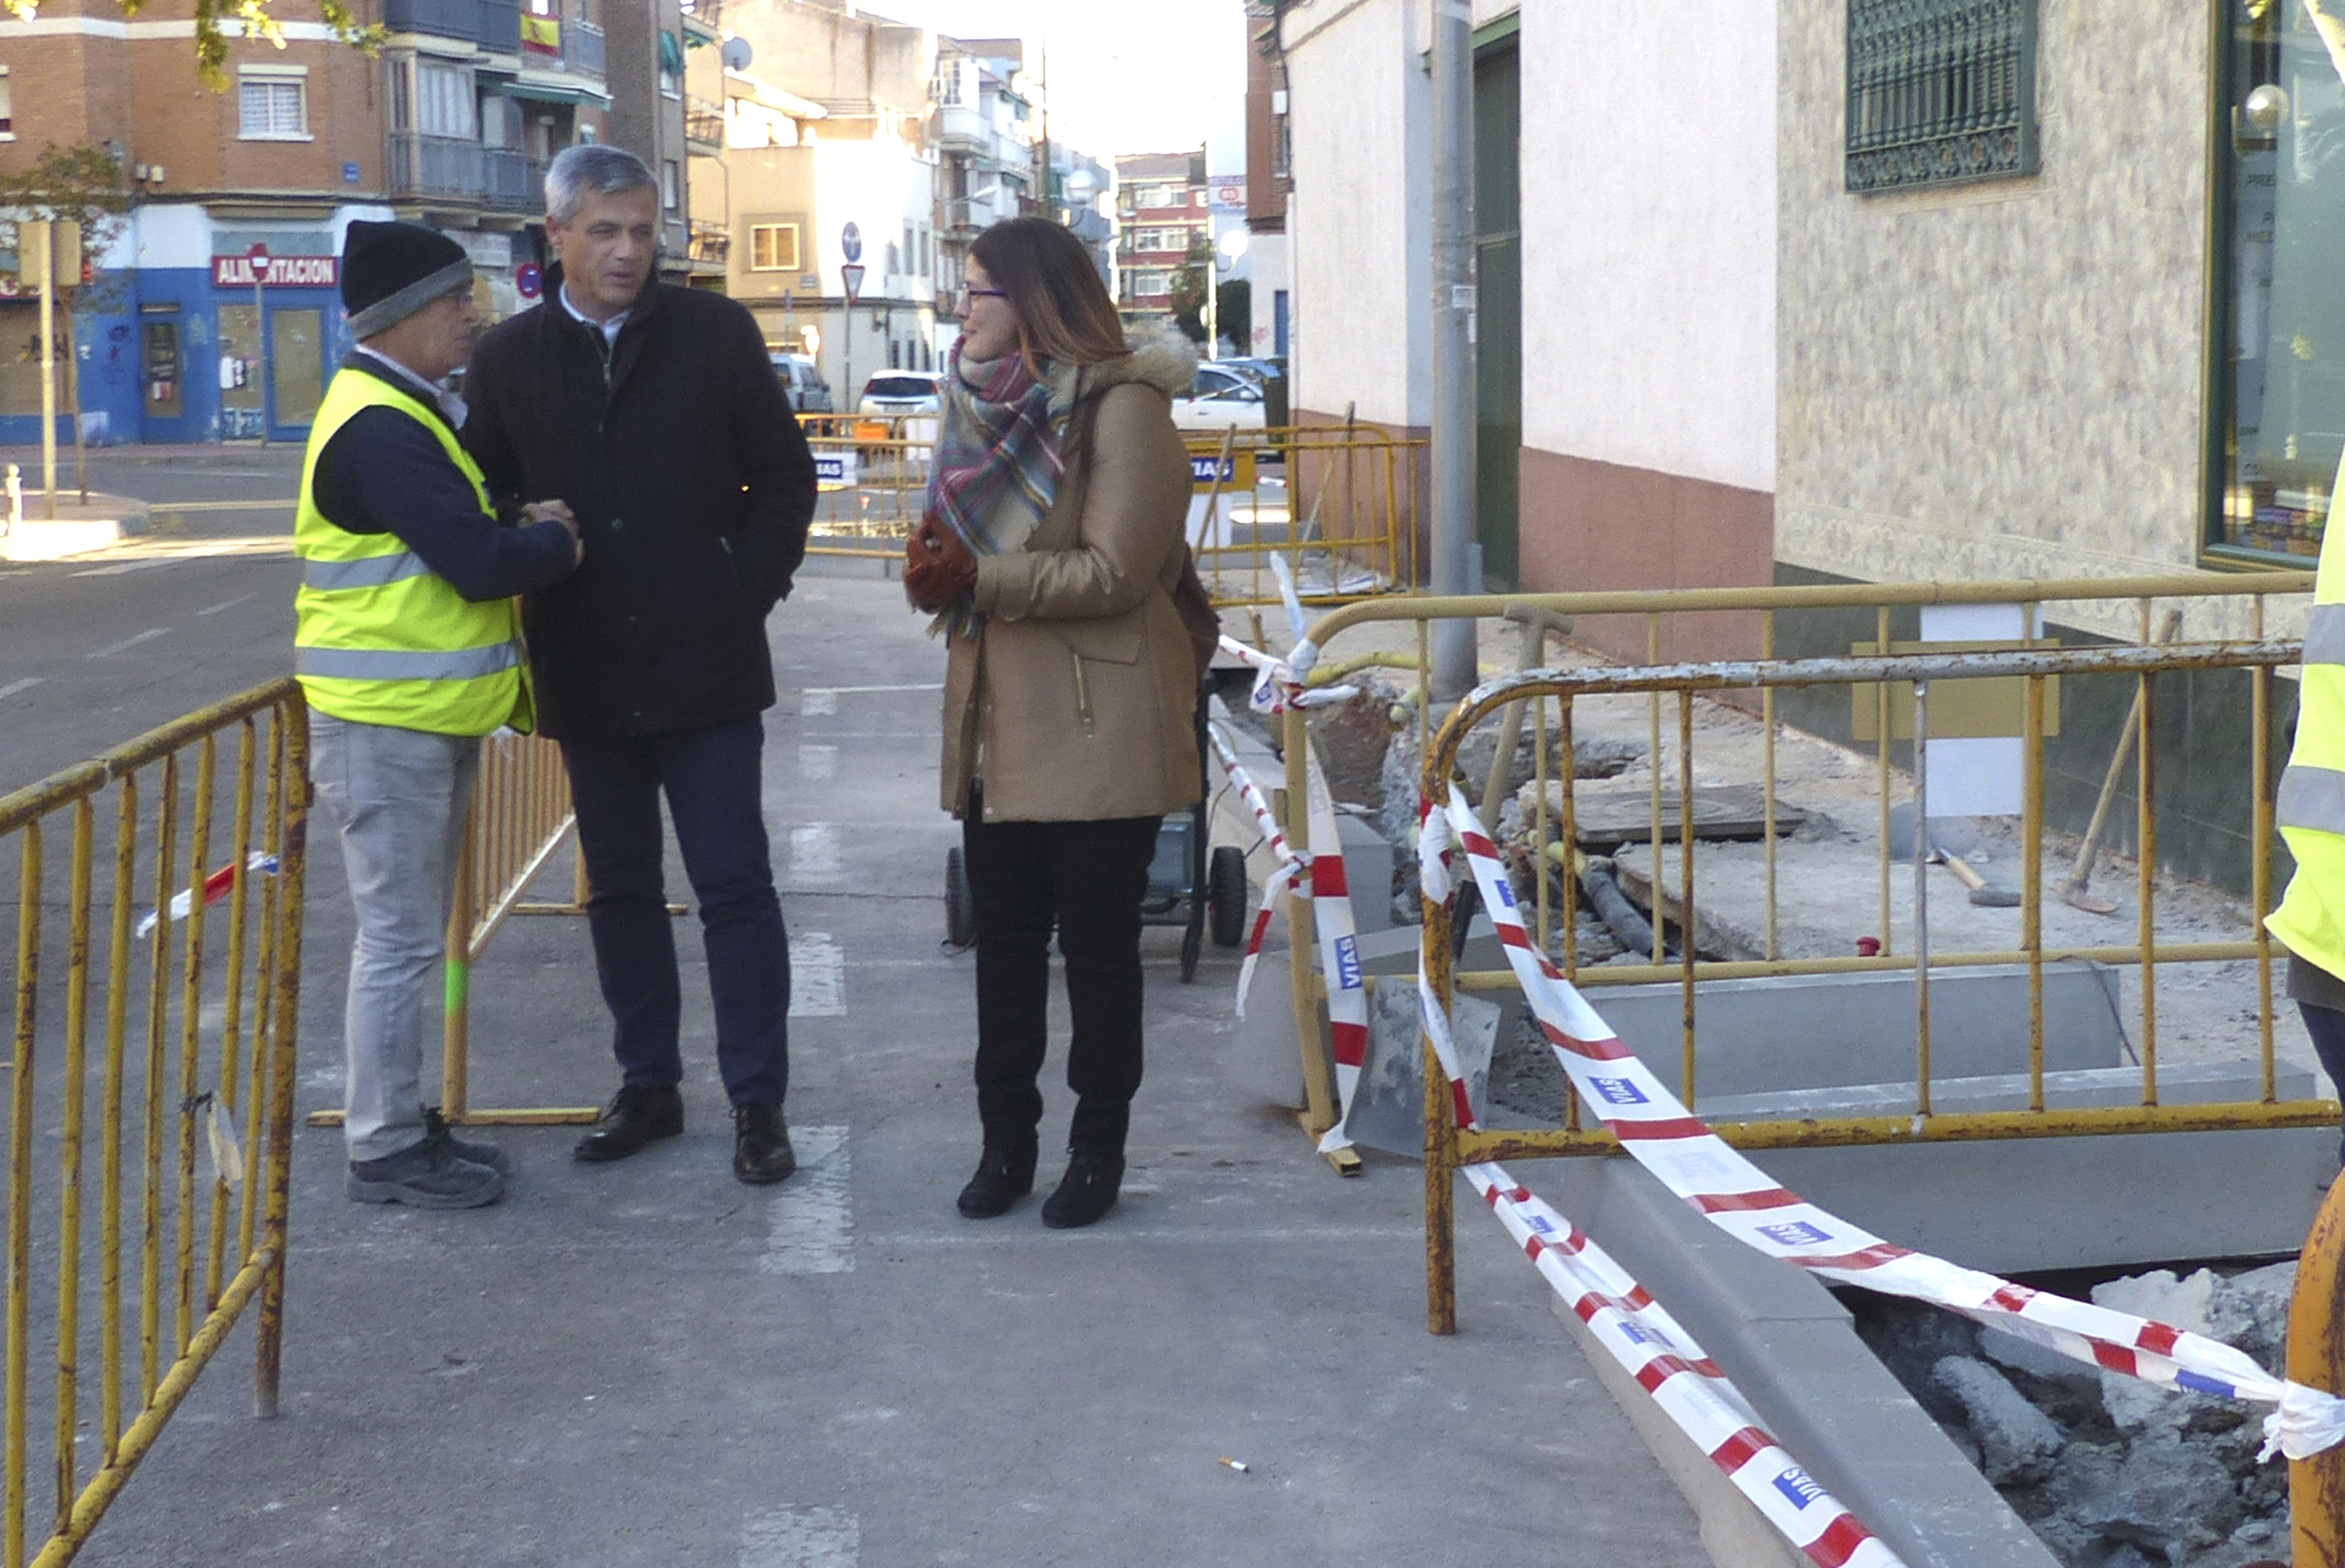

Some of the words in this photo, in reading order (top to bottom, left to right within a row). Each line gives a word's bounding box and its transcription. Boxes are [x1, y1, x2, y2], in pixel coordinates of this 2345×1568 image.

[218, 258, 335, 283] ALIMNTACION
[1191, 462, 1231, 476] IAS
[1340, 937, 1361, 987] VIAS
[1598, 1078, 1639, 1104] VIAS
[1768, 1224, 1819, 1246] VIAS
[1782, 1467, 1826, 1501] VIAS
